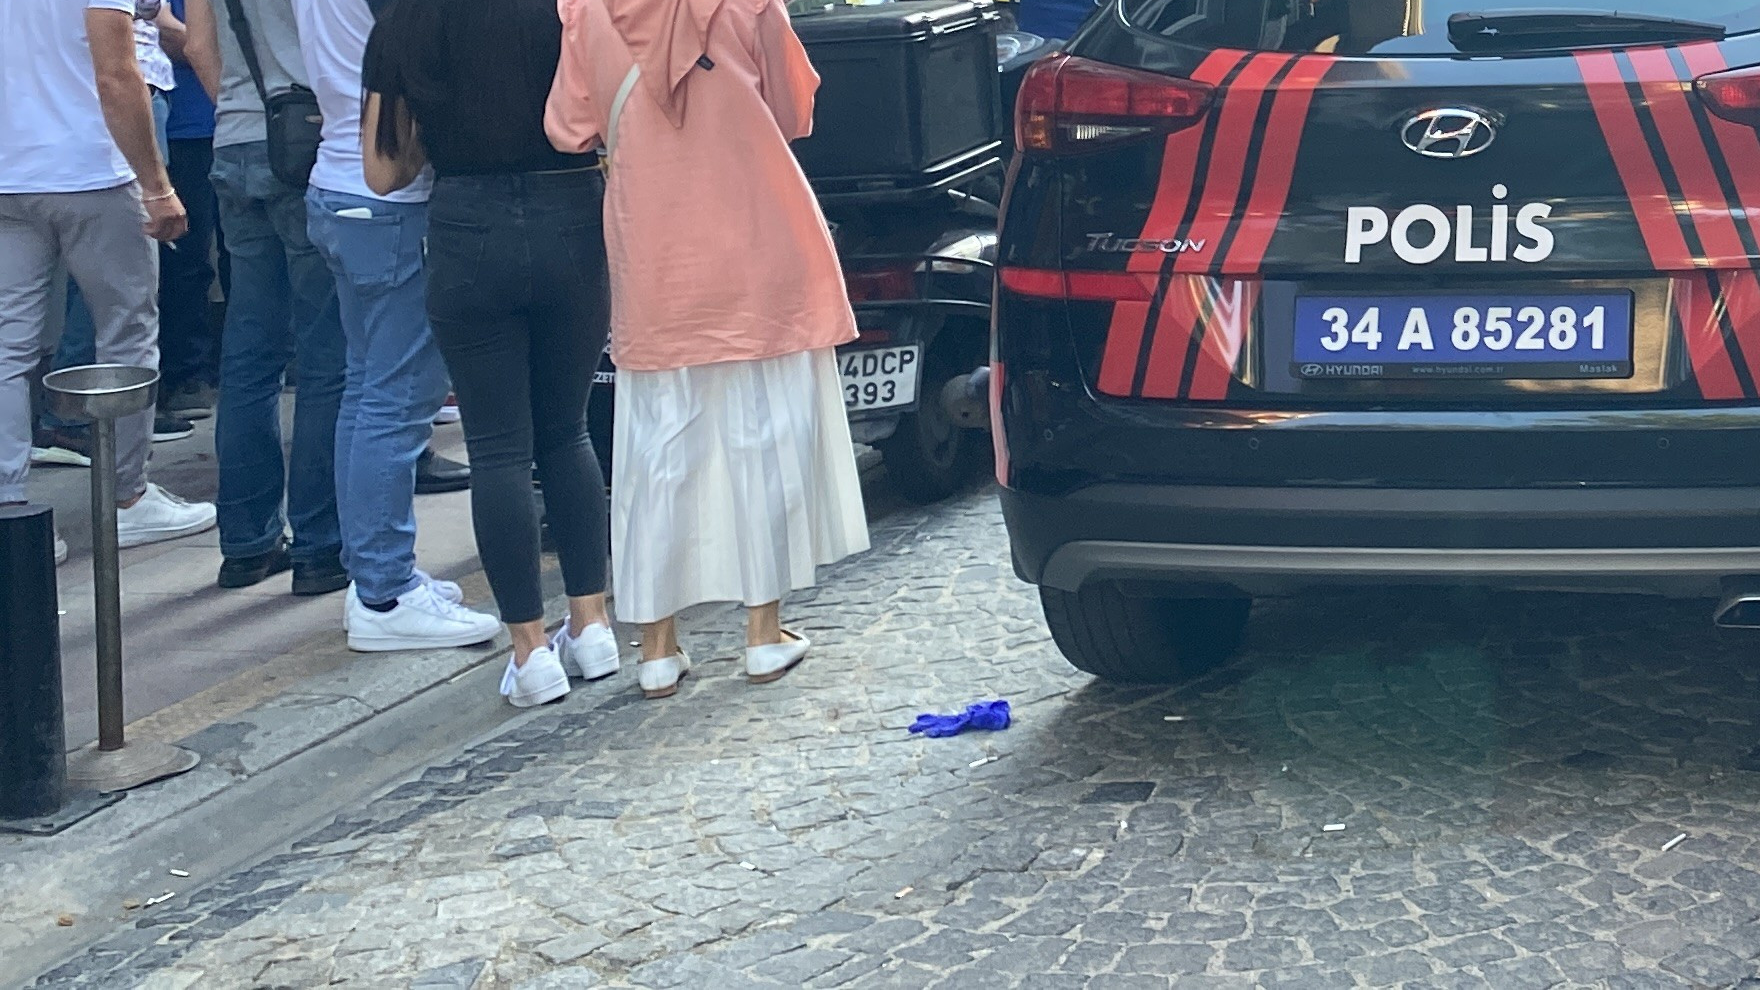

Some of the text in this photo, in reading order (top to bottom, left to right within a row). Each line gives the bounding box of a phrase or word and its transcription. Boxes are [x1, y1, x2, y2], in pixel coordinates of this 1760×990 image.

[1344, 183, 1555, 264] POLİS
[1320, 305, 1606, 351] 34 A 85281
[1325, 364, 1383, 376] HYUNDAI
[845, 380, 896, 407] 393
